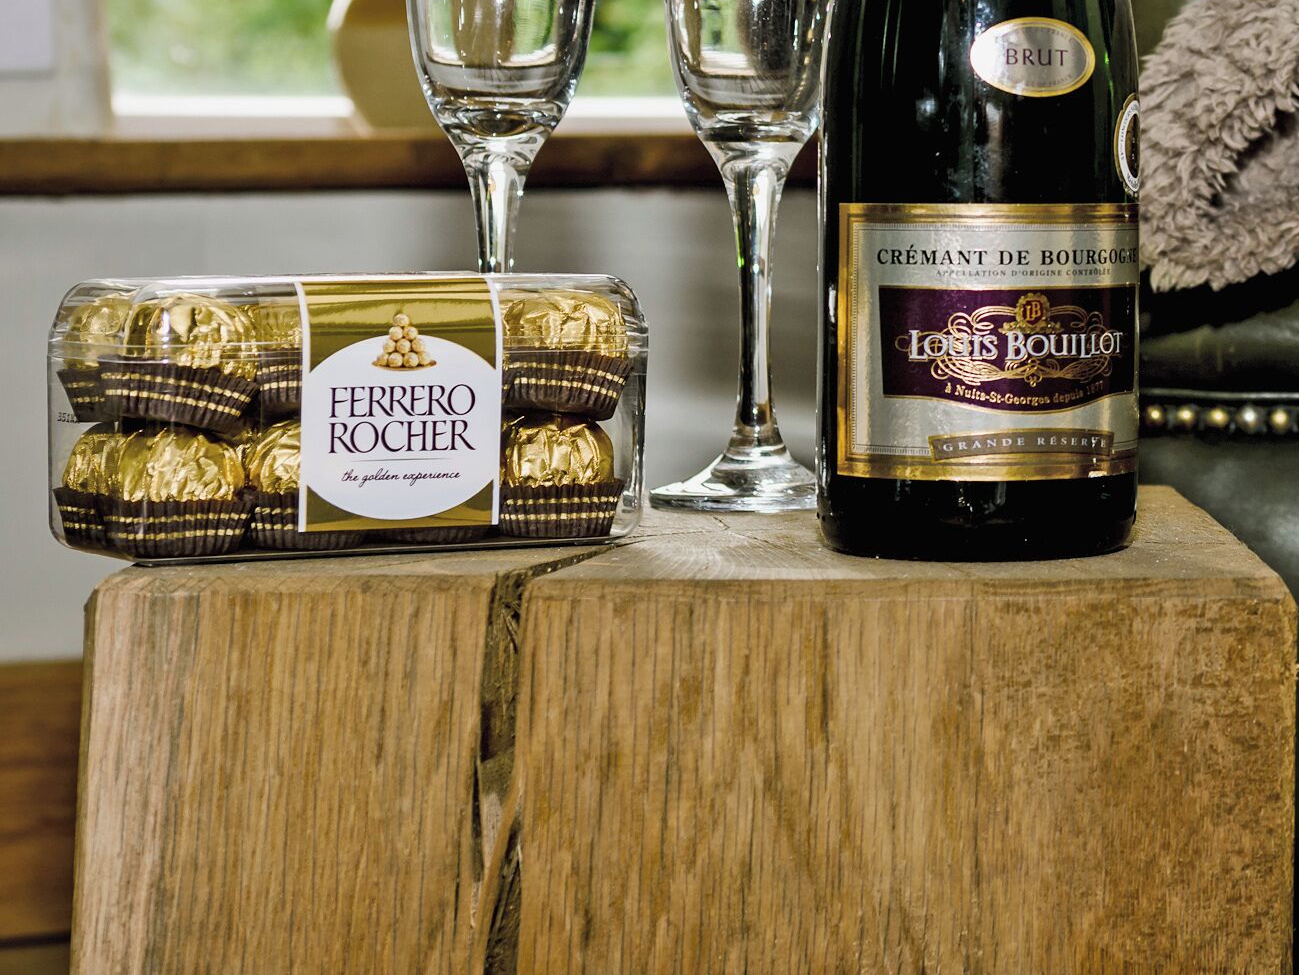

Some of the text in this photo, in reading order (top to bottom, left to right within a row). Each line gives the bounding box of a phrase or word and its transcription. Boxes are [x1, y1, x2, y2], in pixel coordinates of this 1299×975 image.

[1005, 48, 1068, 66] BRUT
[876, 244, 987, 266] CRÉMANT
[998, 249, 1030, 266] DE
[936, 269, 1007, 277] APPELLATION
[1011, 269, 1062, 277] D'ORIGINE
[908, 329, 1123, 362] LOUIS BOUILLOT
[329, 383, 476, 419] FERRERO
[954, 384, 1050, 407] Nuits-St-Georges
[1053, 388, 1084, 405] depuis
[1086, 380, 1104, 396] 1877
[328, 419, 477, 454] ROCHER
[942, 436, 1025, 452] GRANDE
[341, 467, 462, 488] the golden experience
